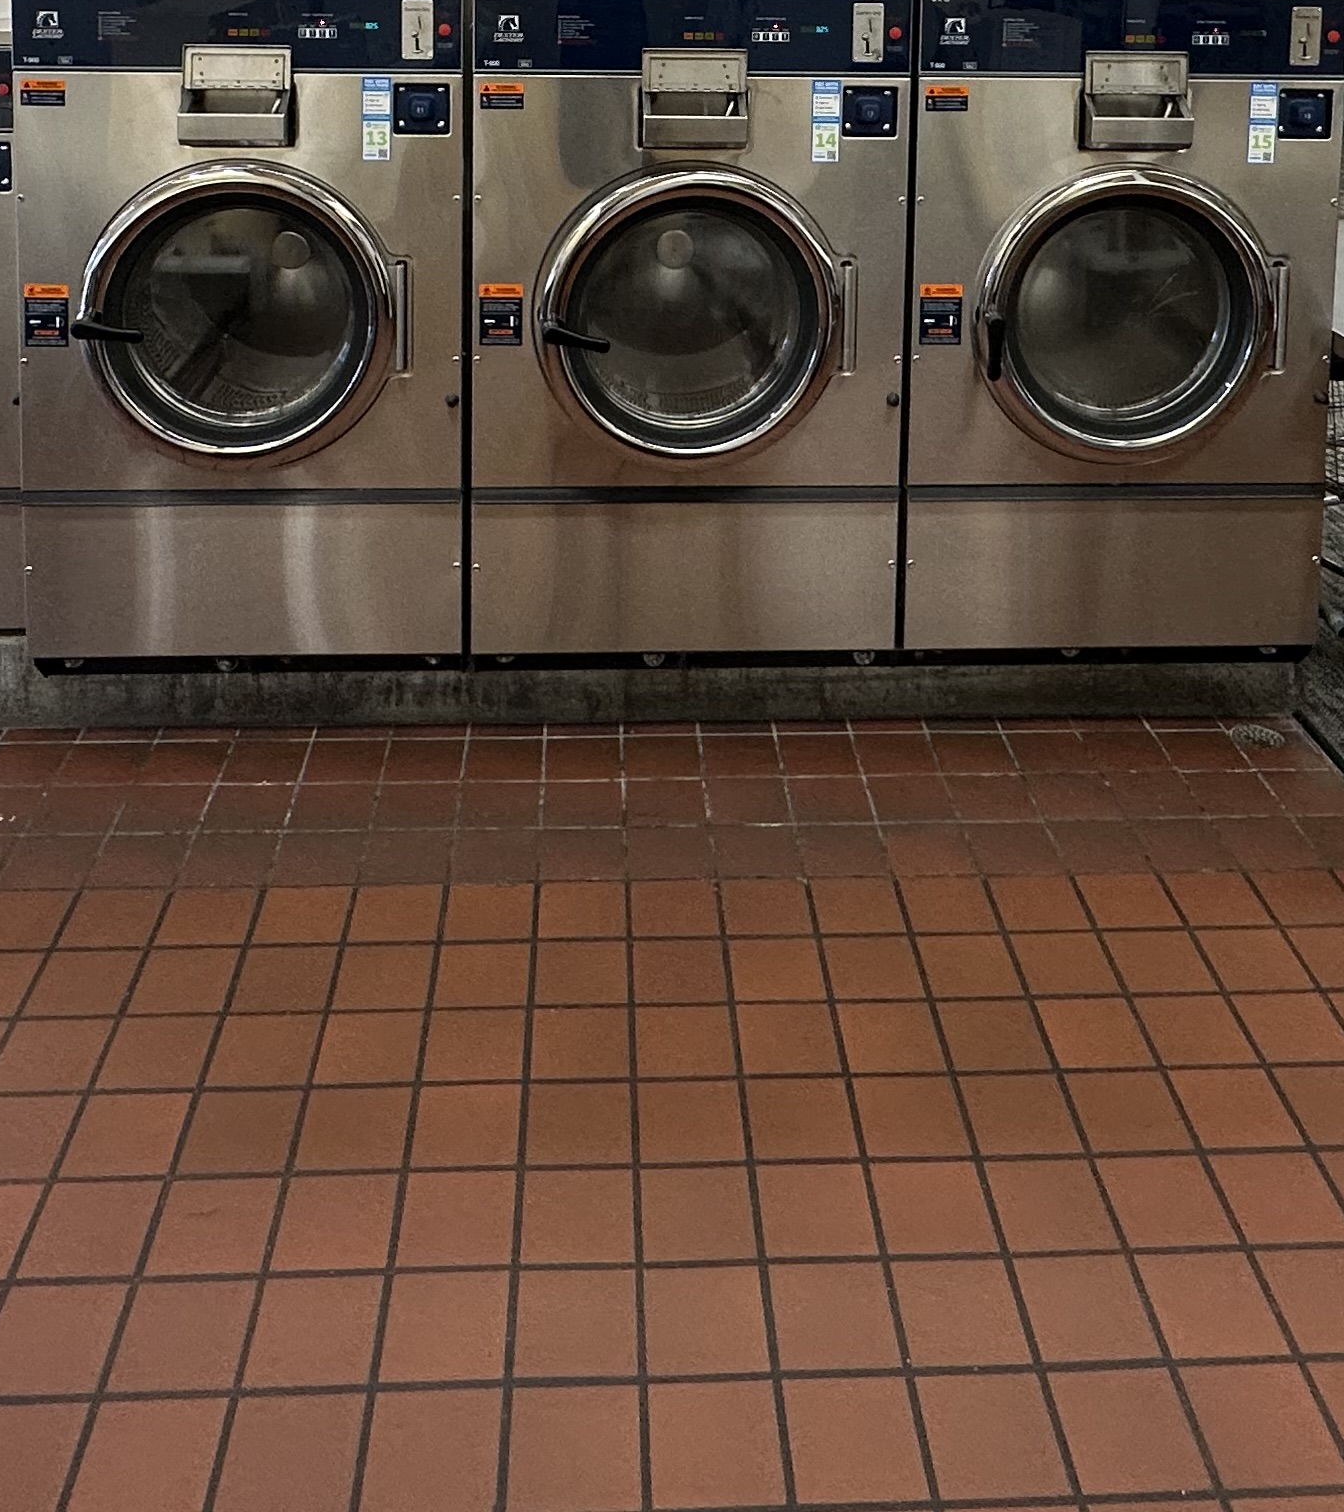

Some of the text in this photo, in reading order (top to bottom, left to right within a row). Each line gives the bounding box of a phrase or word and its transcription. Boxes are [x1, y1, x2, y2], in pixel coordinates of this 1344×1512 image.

[365, 130, 388, 146] 13
[815, 133, 837, 148] 14
[1251, 135, 1272, 150] 15
